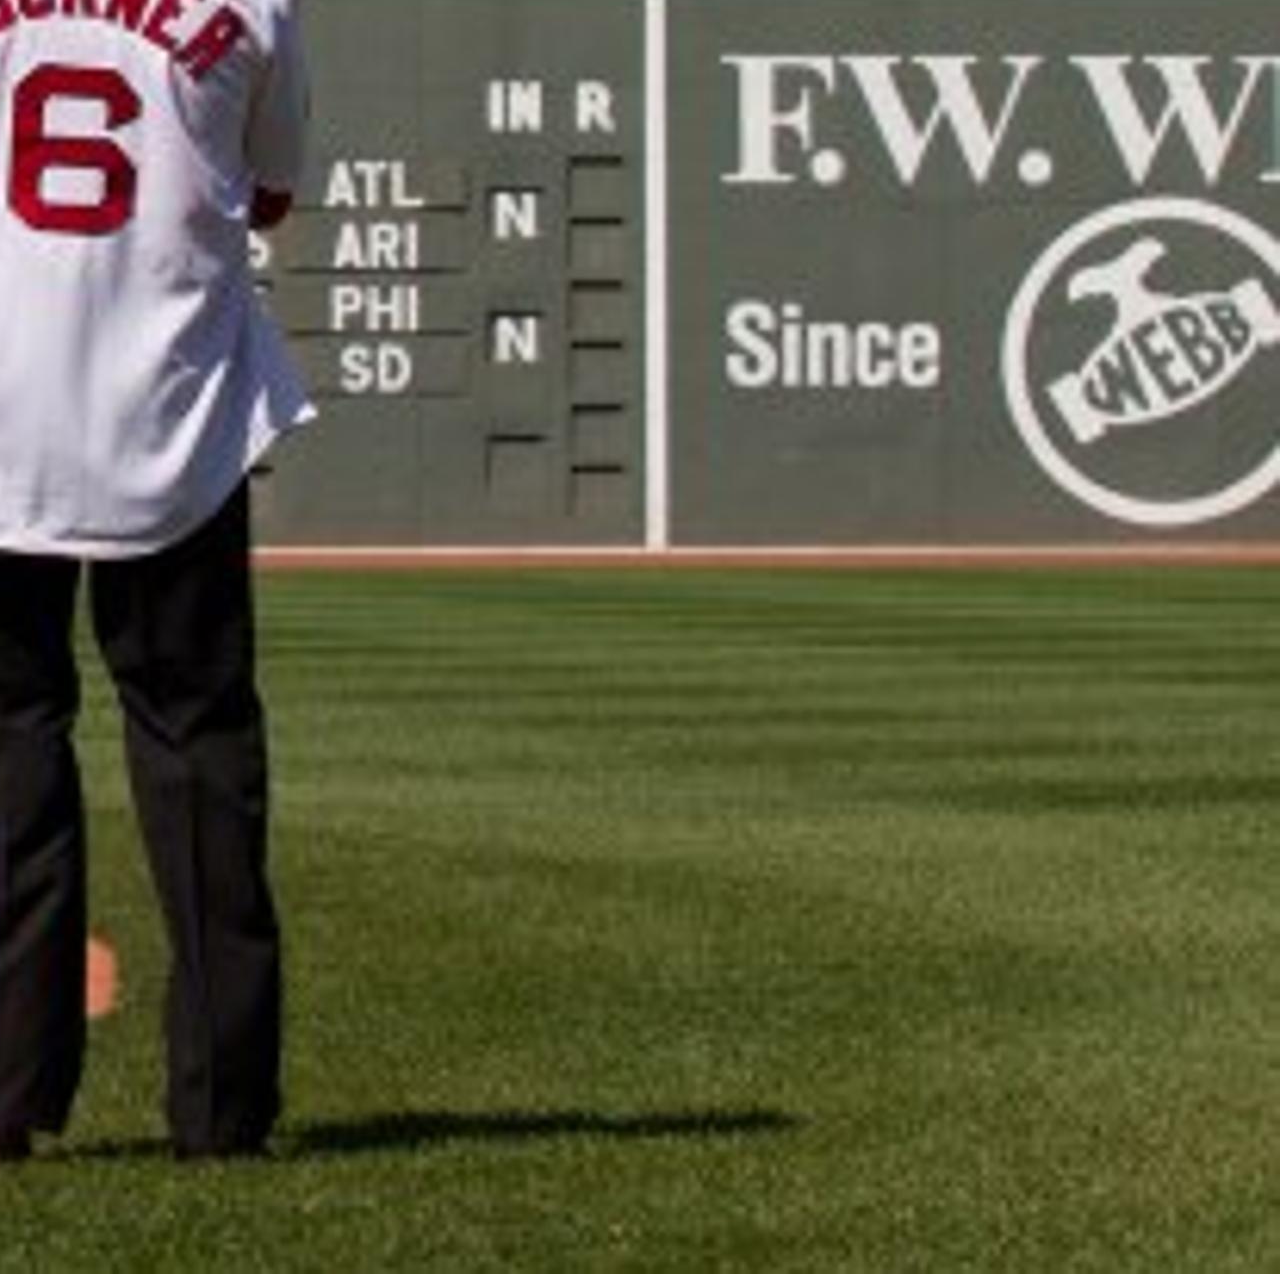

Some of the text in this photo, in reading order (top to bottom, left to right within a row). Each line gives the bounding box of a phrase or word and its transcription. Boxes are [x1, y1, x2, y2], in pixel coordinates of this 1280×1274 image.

[489, 81, 613, 130] IN R
[721, 55, 1280, 184] F.W. W
[7, 62, 143, 237] 6
[324, 160, 424, 207] ATL
[495, 193, 536, 238] N
[333, 222, 418, 268] ARI
[331, 284, 419, 331] PHI
[496, 317, 537, 361] N
[726, 301, 940, 388] Since
[1082, 300, 1252, 418] WEBB
[340, 342, 412, 392] SD
